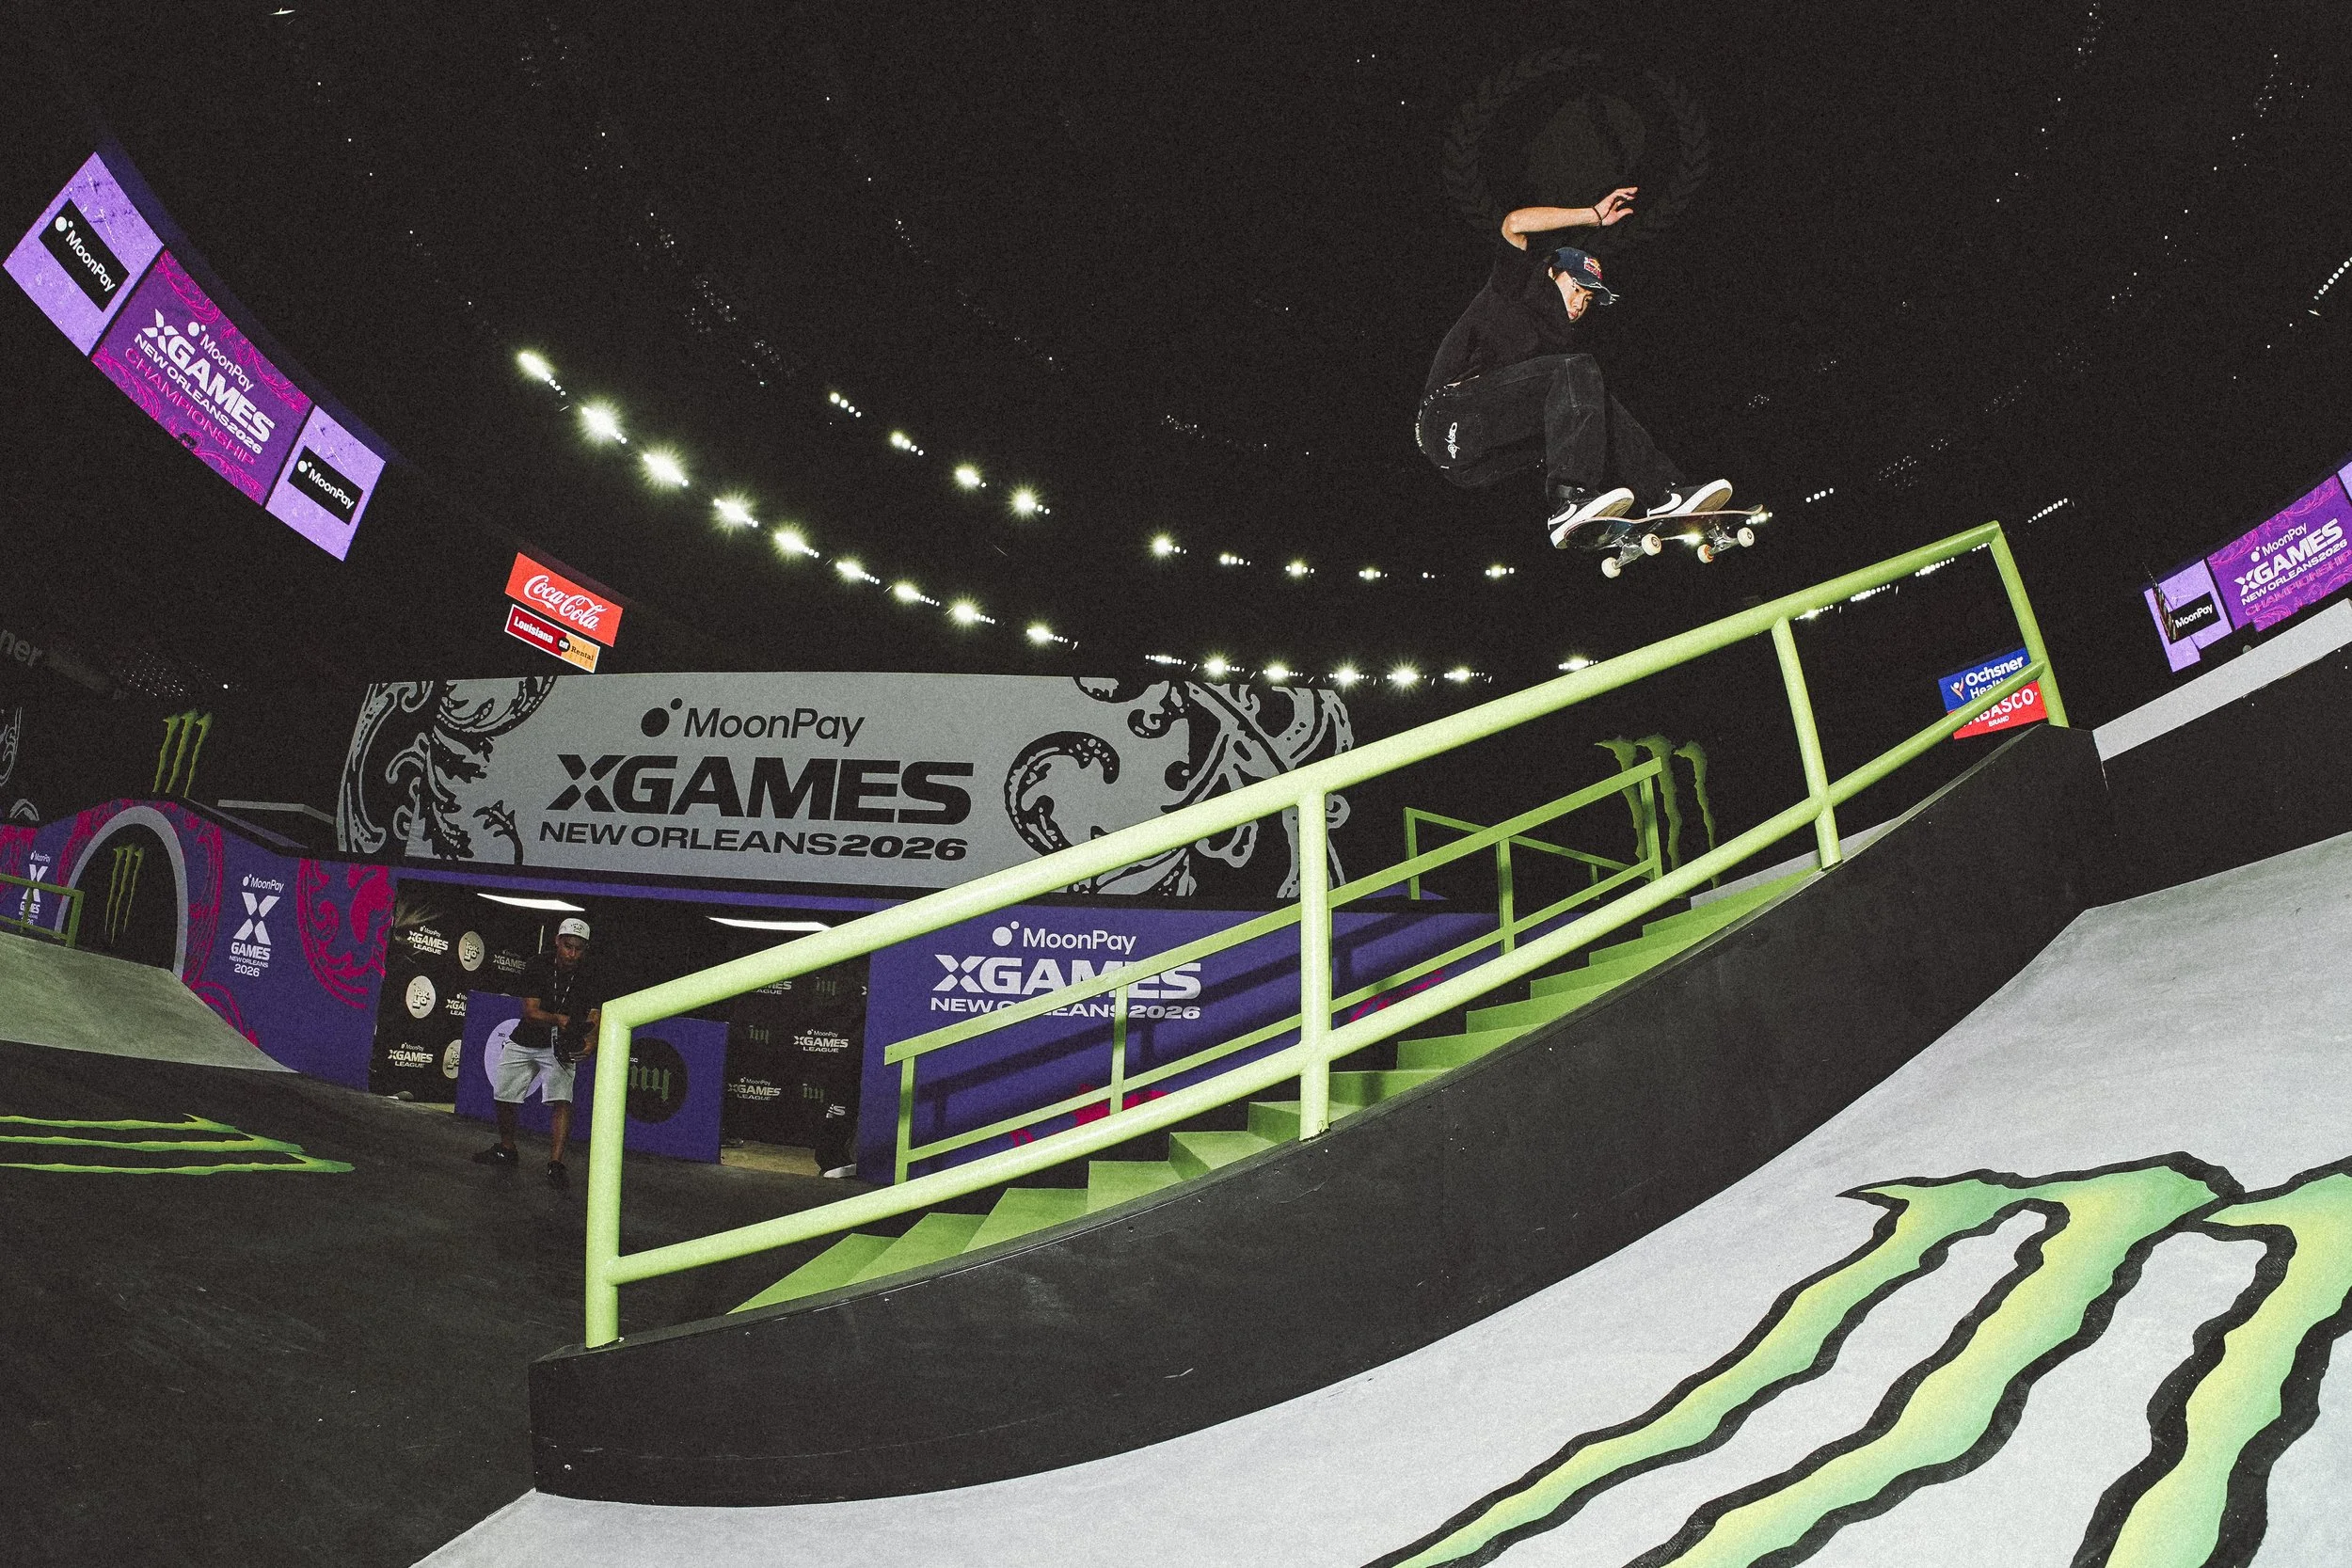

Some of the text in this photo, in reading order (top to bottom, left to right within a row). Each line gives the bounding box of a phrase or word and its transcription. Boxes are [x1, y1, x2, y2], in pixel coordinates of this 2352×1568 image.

[66, 230, 116, 292] MoonPay
[200, 335, 254, 391] MoonPay
[126, 348, 255, 466] CHAMPIONSHIP
[135, 334, 263, 455] NEW ORLEANS 2026
[309, 470, 354, 509] MoonPay
[2262, 522, 2307, 556] MoonPay
[2241, 538, 2348, 606] NEW ORLEANS 2026
[2246, 549, 2352, 616] CHAMPIONSHIP
[2175, 605, 2213, 628] MoonPay
[514, 616, 553, 644] Louisiana
[571, 646, 595, 661] Rental
[1965, 657, 2024, 687] Ochsner
[684, 706, 865, 748] MoonPay
[1988, 715, 2010, 727] BRAND
[546, 753, 974, 825] XGAMES
[539, 820, 968, 862] NEW ORLEANS 2026
[250, 876, 284, 893] MoonPay
[230, 942, 271, 960] GAMES
[1023, 927, 1136, 955] MoonPay
[234, 963, 260, 977] 2026
[242, 958, 268, 968] ORLEANS
[930, 997, 993, 1013] NEW
[1129, 1006, 1200, 1020] 2026
